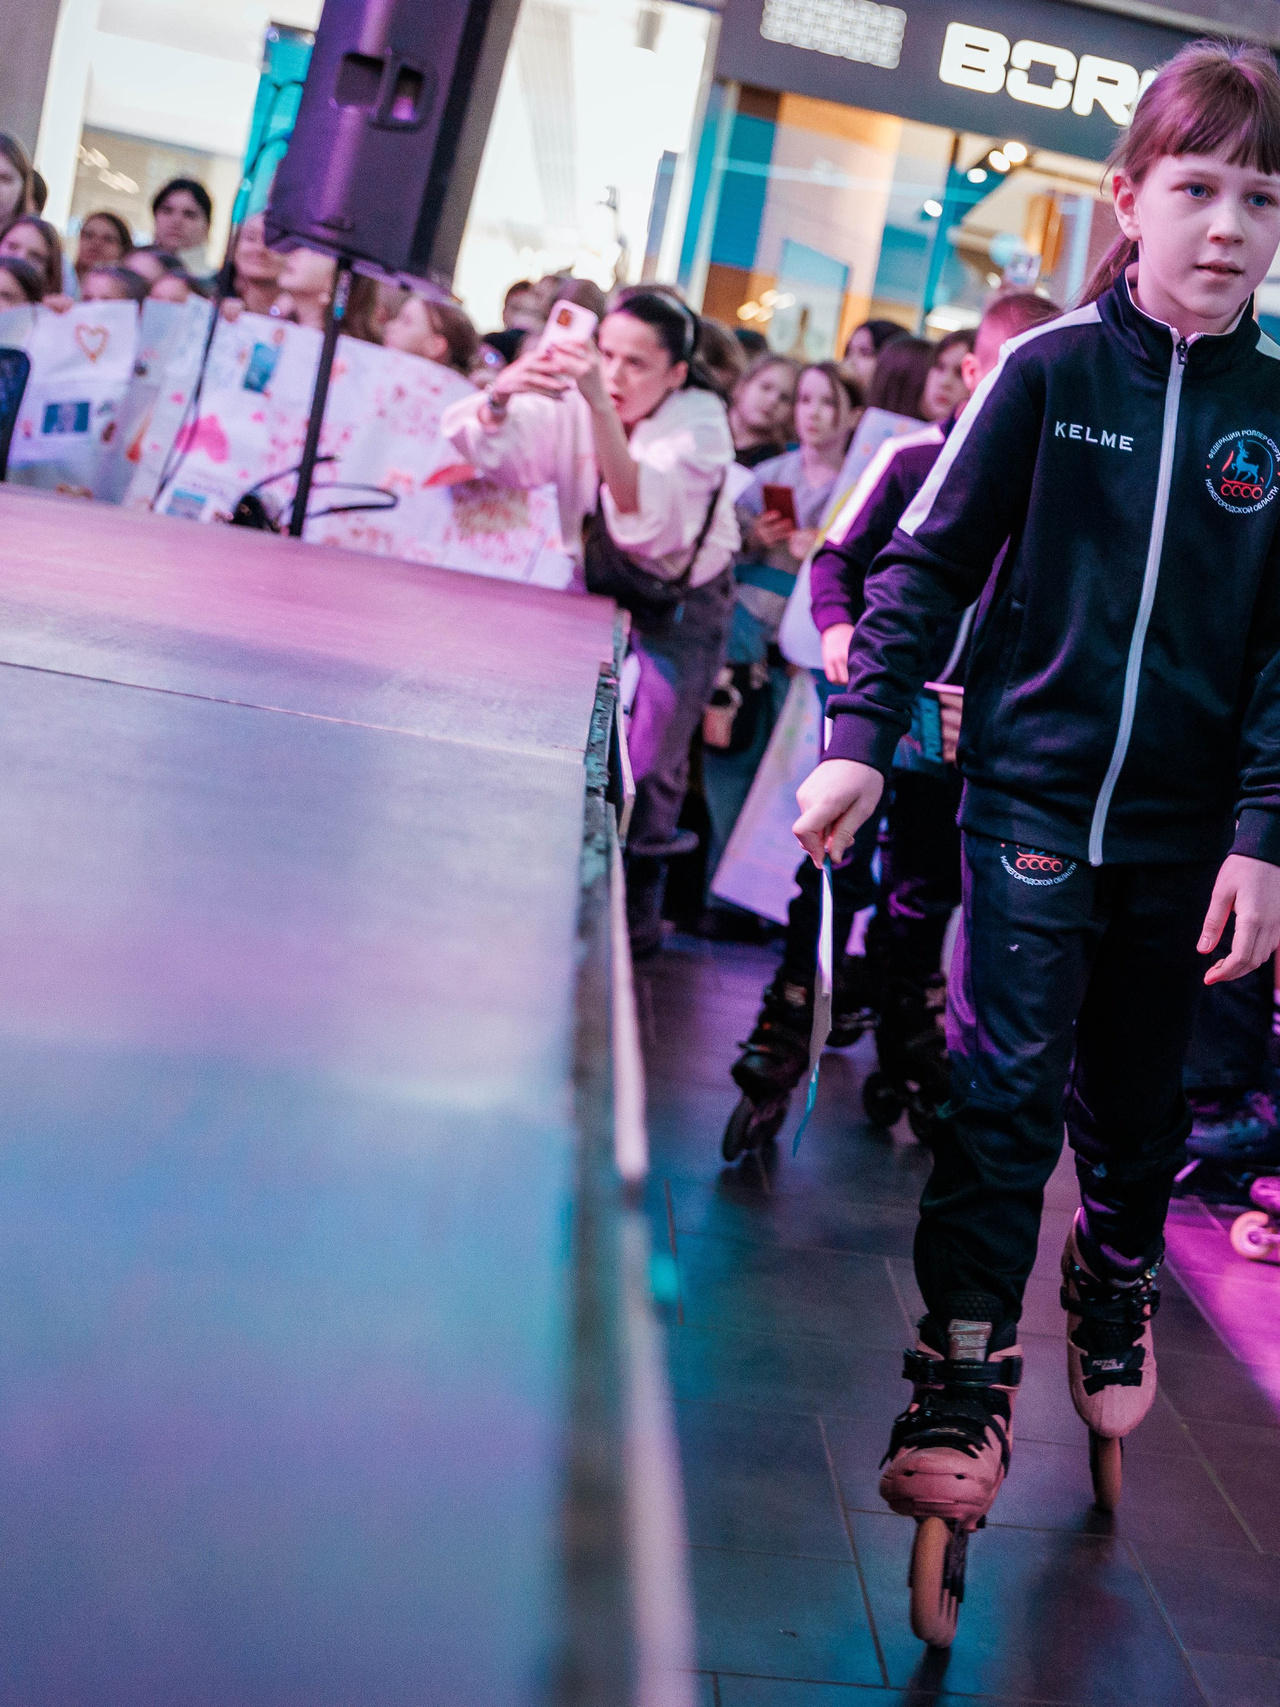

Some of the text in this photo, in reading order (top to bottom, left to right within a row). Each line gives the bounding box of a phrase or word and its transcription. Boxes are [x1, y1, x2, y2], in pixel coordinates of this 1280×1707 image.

[938, 21, 1158, 127] BOR
[1055, 421, 1134, 452] KELME
[1208, 430, 1241, 459] ФЕДЕРАЦИЯ
[1241, 429, 1268, 441] РОЛЛЕР
[1204, 478, 1280, 514] НИЖЕГОРОДСКОЙ ОБЛАСТИ
